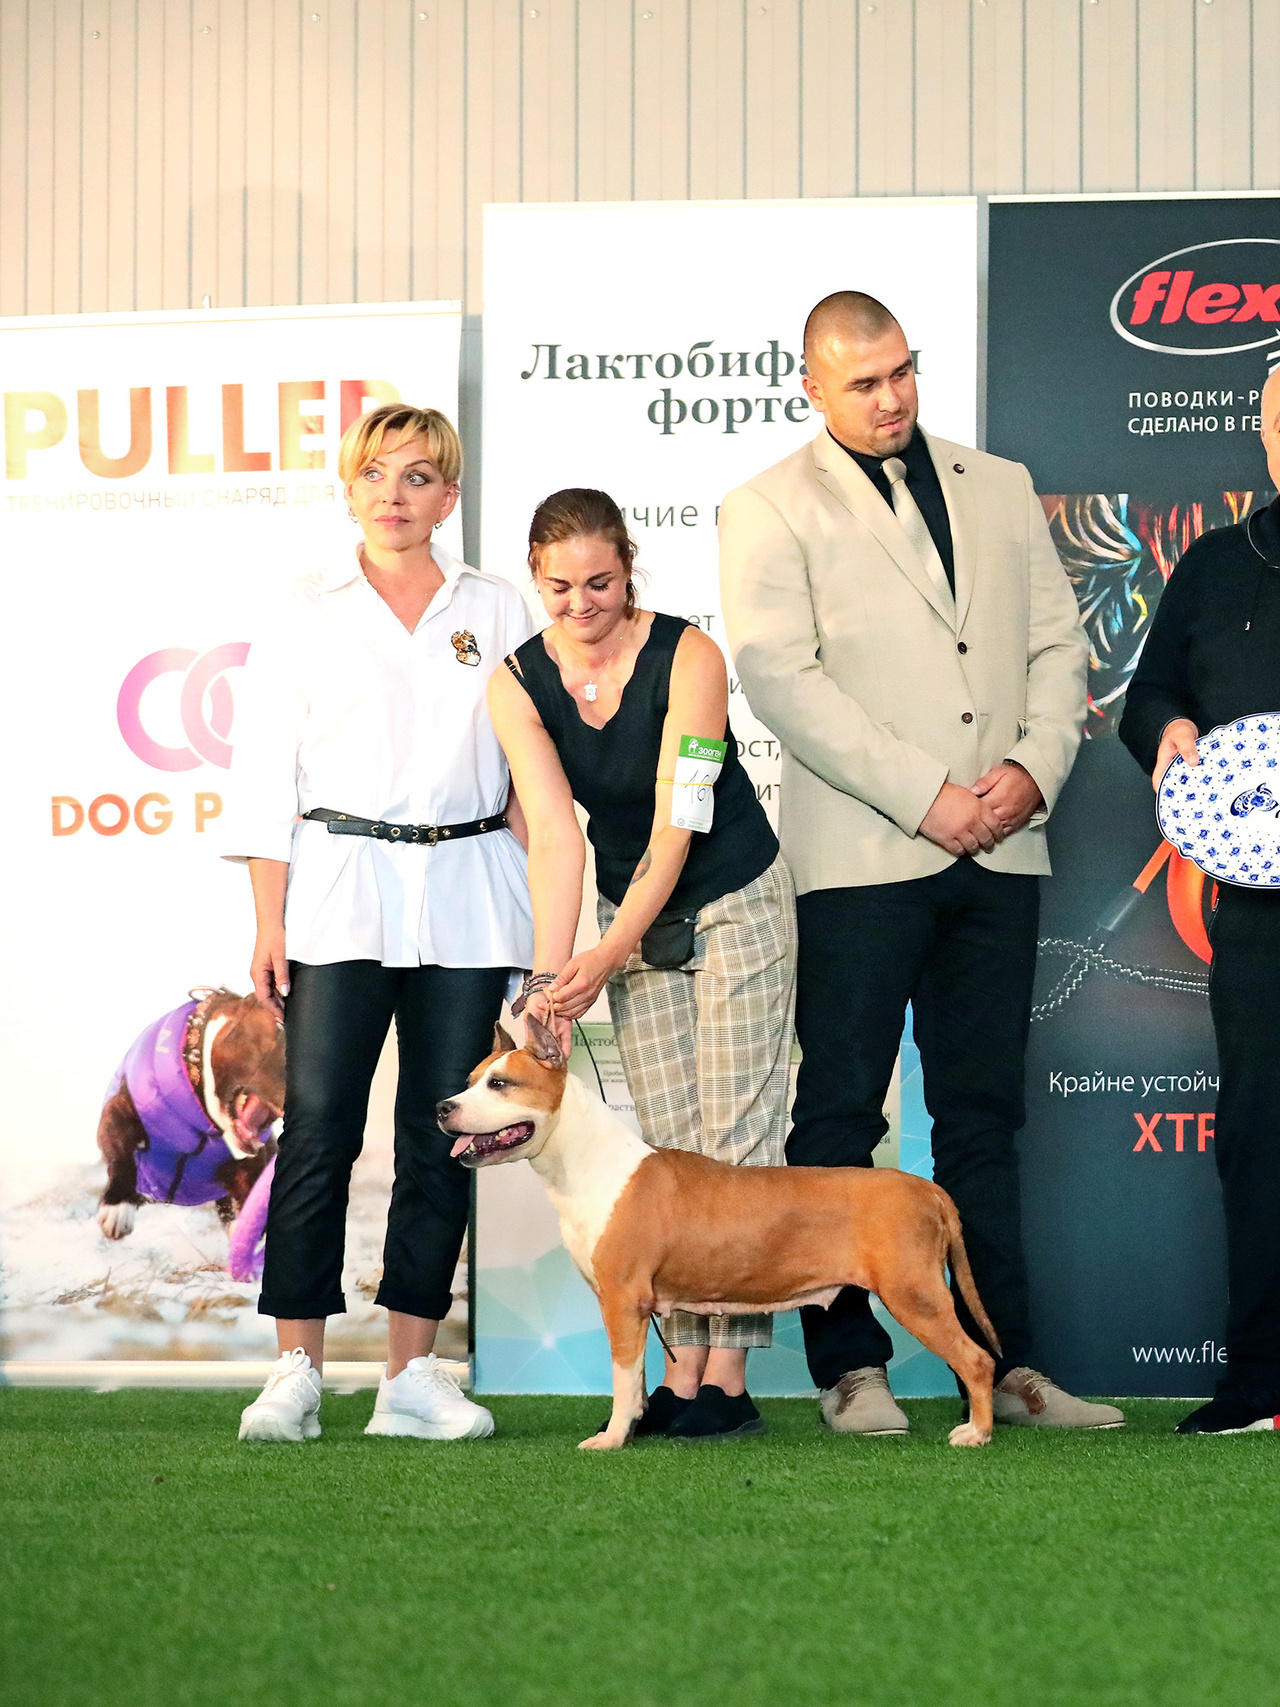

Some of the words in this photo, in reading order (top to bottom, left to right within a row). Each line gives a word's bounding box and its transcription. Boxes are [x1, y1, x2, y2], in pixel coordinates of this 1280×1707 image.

[521, 340, 922, 388] Лактобиф
[647, 389, 810, 435] форте
[1128, 390, 1260, 409] ПОВОДКИ-Р
[1128, 415, 1218, 436] СДЕЛАНО
[1225, 416, 1235, 432] В
[1242, 415, 1261, 431] ГЕ
[6, 485, 196, 513] ТРЕНИРОВОЧНЫЙ
[203, 486, 287, 508] СНАРЯД
[294, 485, 335, 506] ДЛЯ
[51, 793, 174, 836] DOG
[195, 792, 223, 833] P
[1049, 1071, 1135, 1096] Крайне
[1141, 1071, 1220, 1095] устойч
